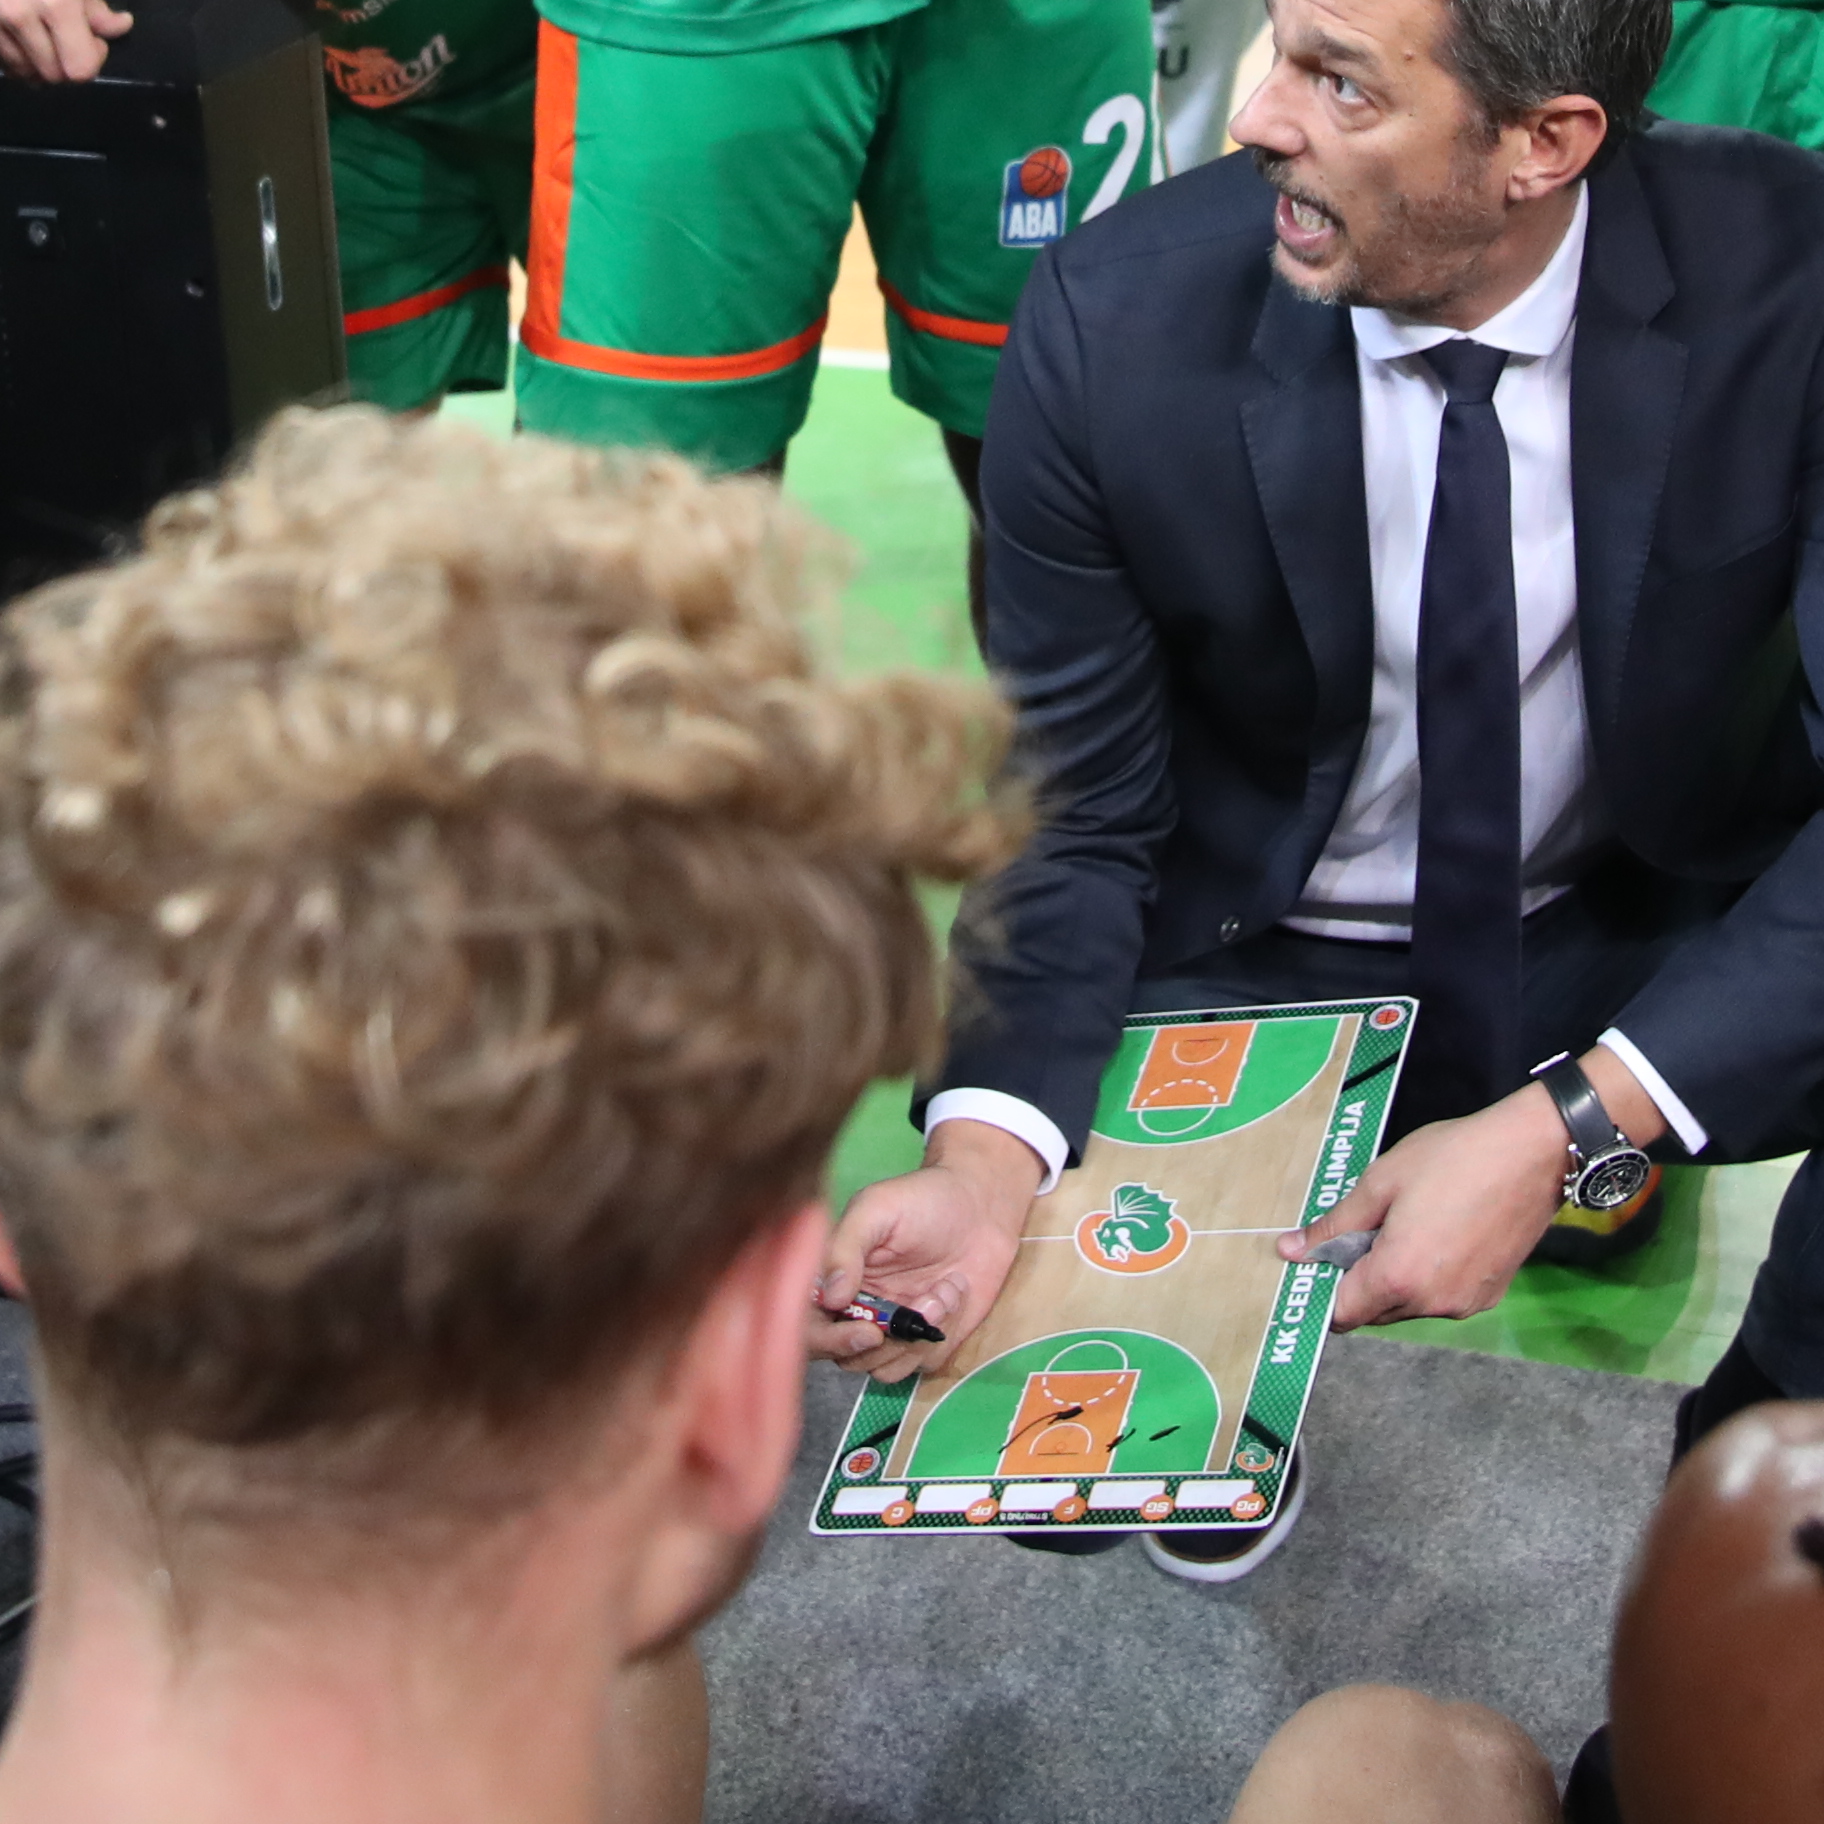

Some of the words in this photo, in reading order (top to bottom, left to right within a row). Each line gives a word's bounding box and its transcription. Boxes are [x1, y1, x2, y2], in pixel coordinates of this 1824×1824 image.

[1008, 200, 1059, 240] ABA
[1270, 1327, 1300, 1365] KK
[1317, 1099, 1368, 1207] OLIMPIJA
[890, 1507, 905, 1518] C
[971, 1504, 993, 1517] PF
[1064, 1504, 1076, 1515] F
[1144, 1500, 1170, 1514] SG
[1235, 1499, 1262, 1514] PG
